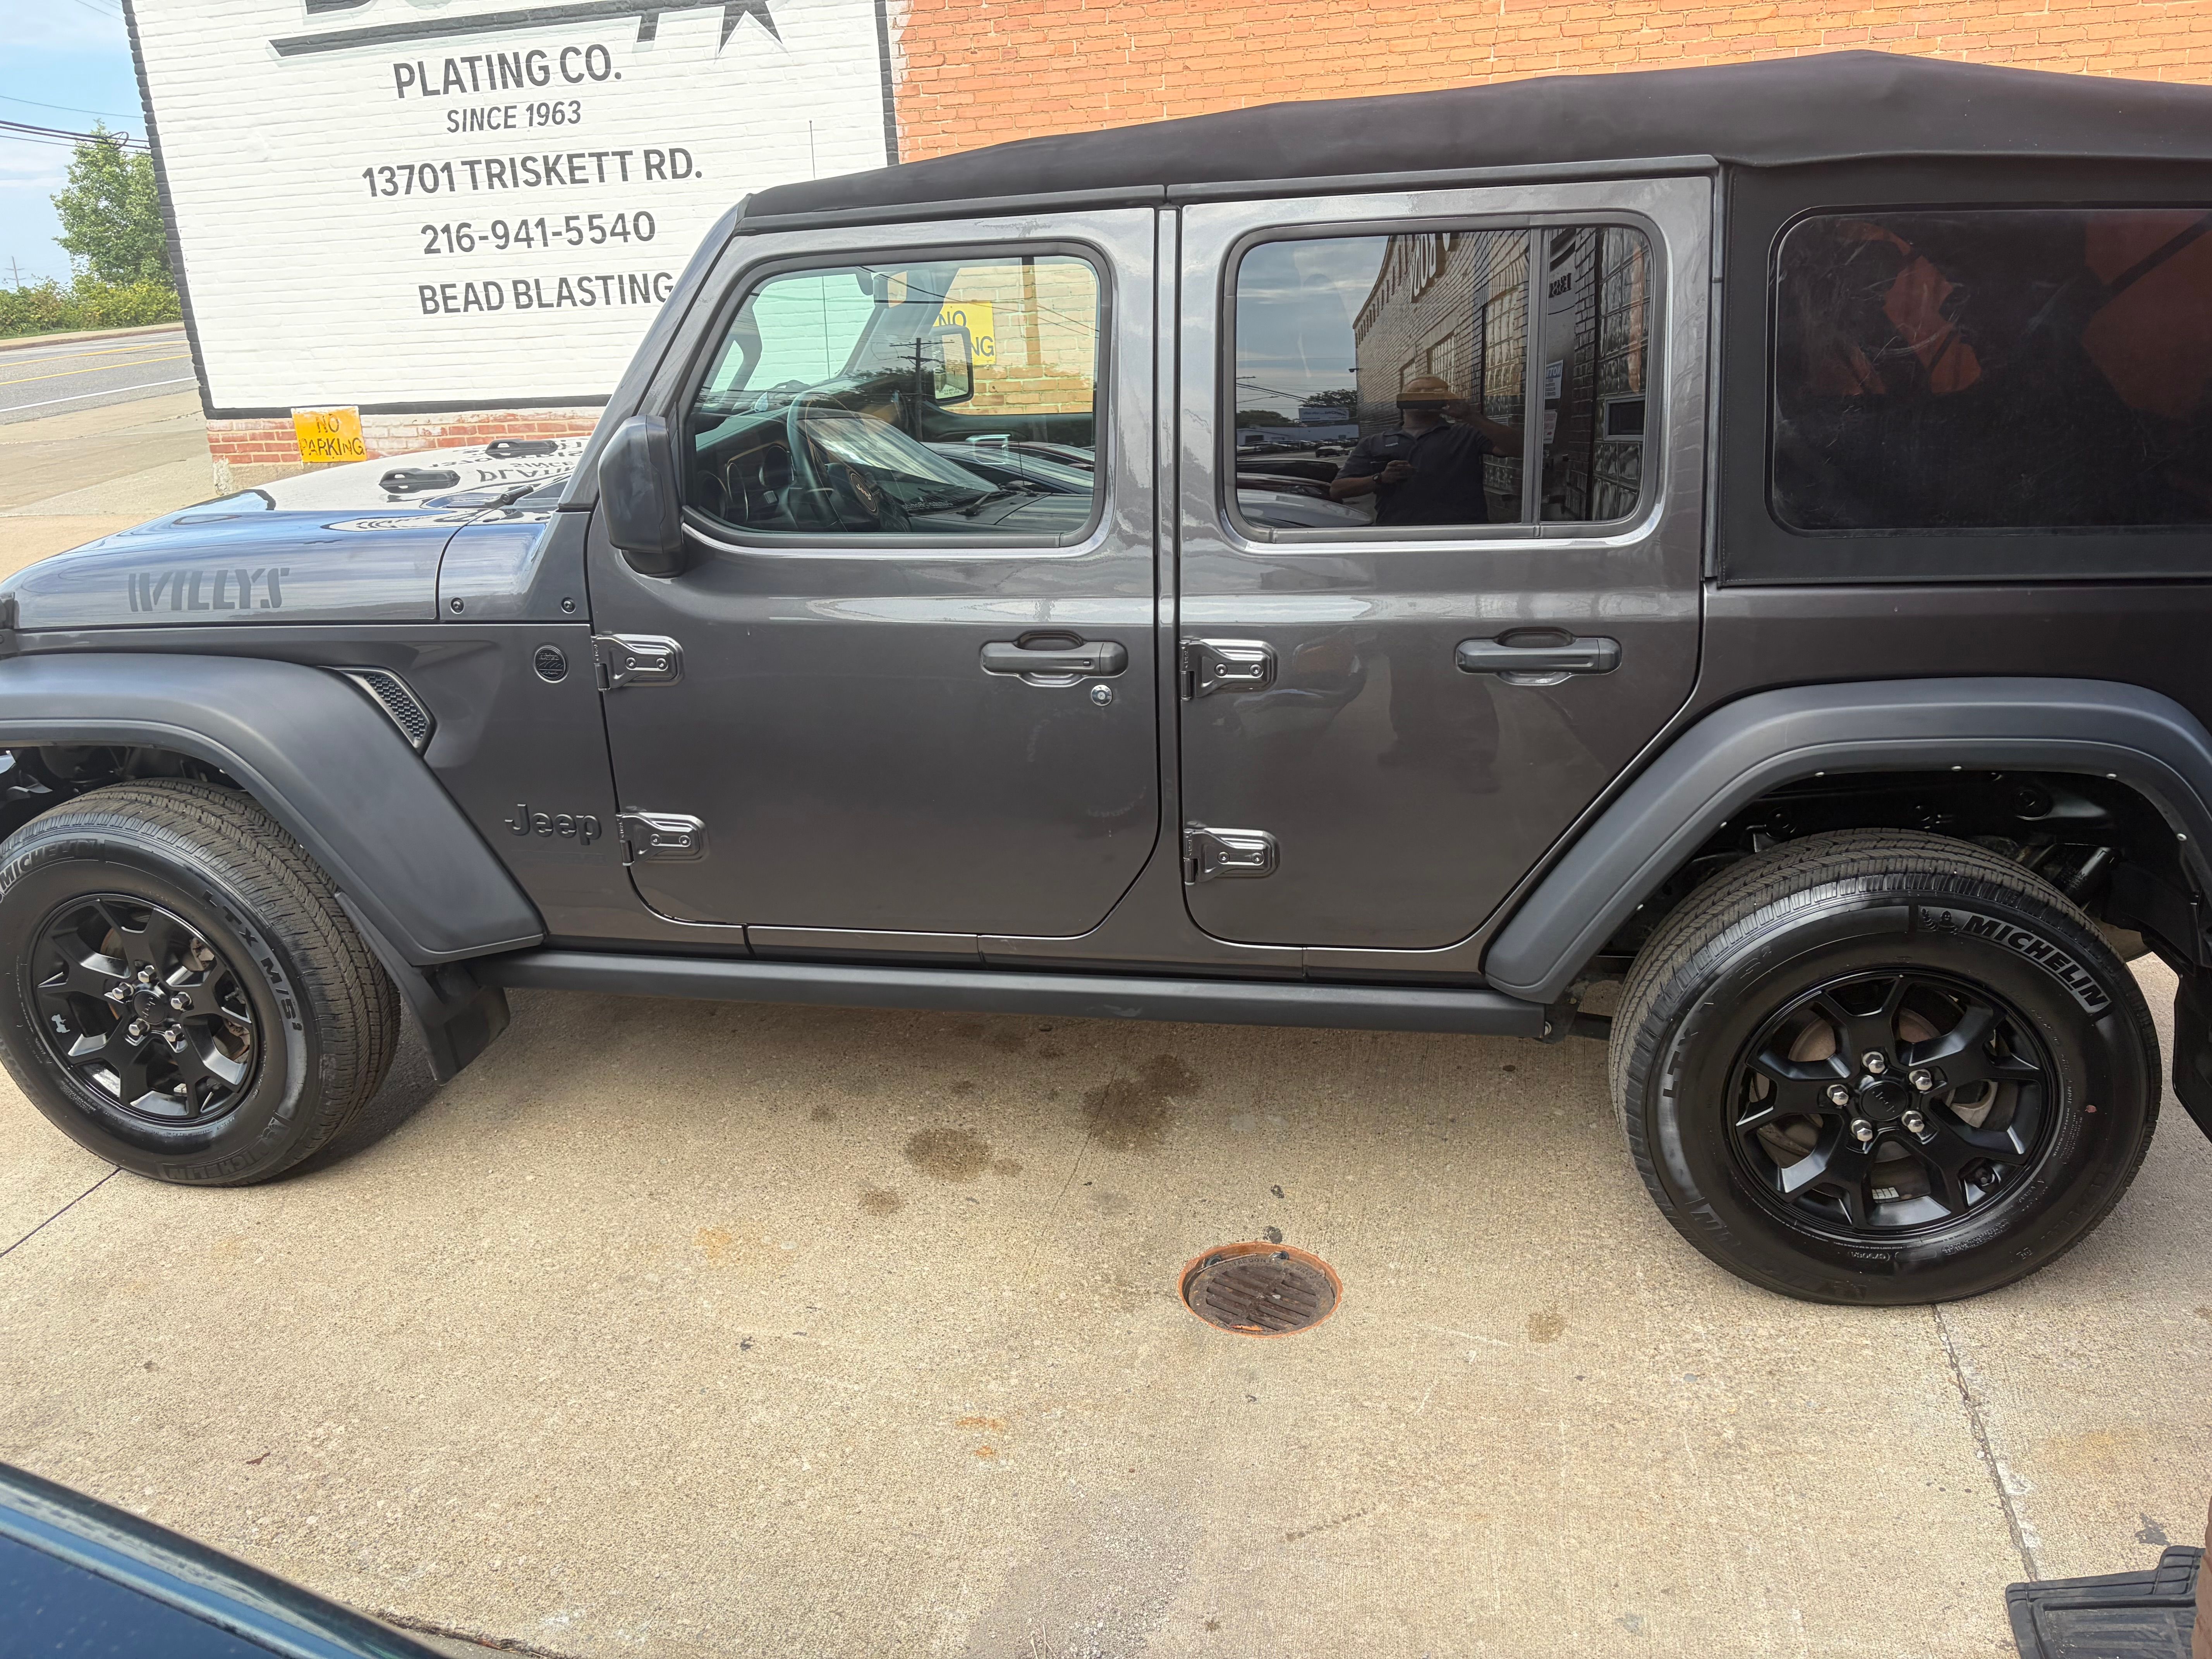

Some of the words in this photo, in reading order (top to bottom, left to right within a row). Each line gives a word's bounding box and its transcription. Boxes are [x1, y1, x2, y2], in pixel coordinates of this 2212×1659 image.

[393, 50, 550, 98] PLATING
[560, 44, 621, 83] CO.
[447, 105, 517, 132] SINCE
[526, 101, 581, 126] 1963
[362, 162, 455, 197] 13701
[461, 151, 633, 190] TRISKETT
[644, 148, 702, 180] RD.
[421, 211, 655, 254] 216-941-5540
[419, 282, 504, 314] BEAD
[513, 272, 673, 309] BLASTING
[316, 414, 339, 433] NO
[299, 438, 364, 456] PARKING
[128, 567, 289, 612] WILLYS
[505, 804, 602, 845] Jeep
[202, 890, 258, 947] LTX
[1963, 915, 2109, 1008] MICHELIN
